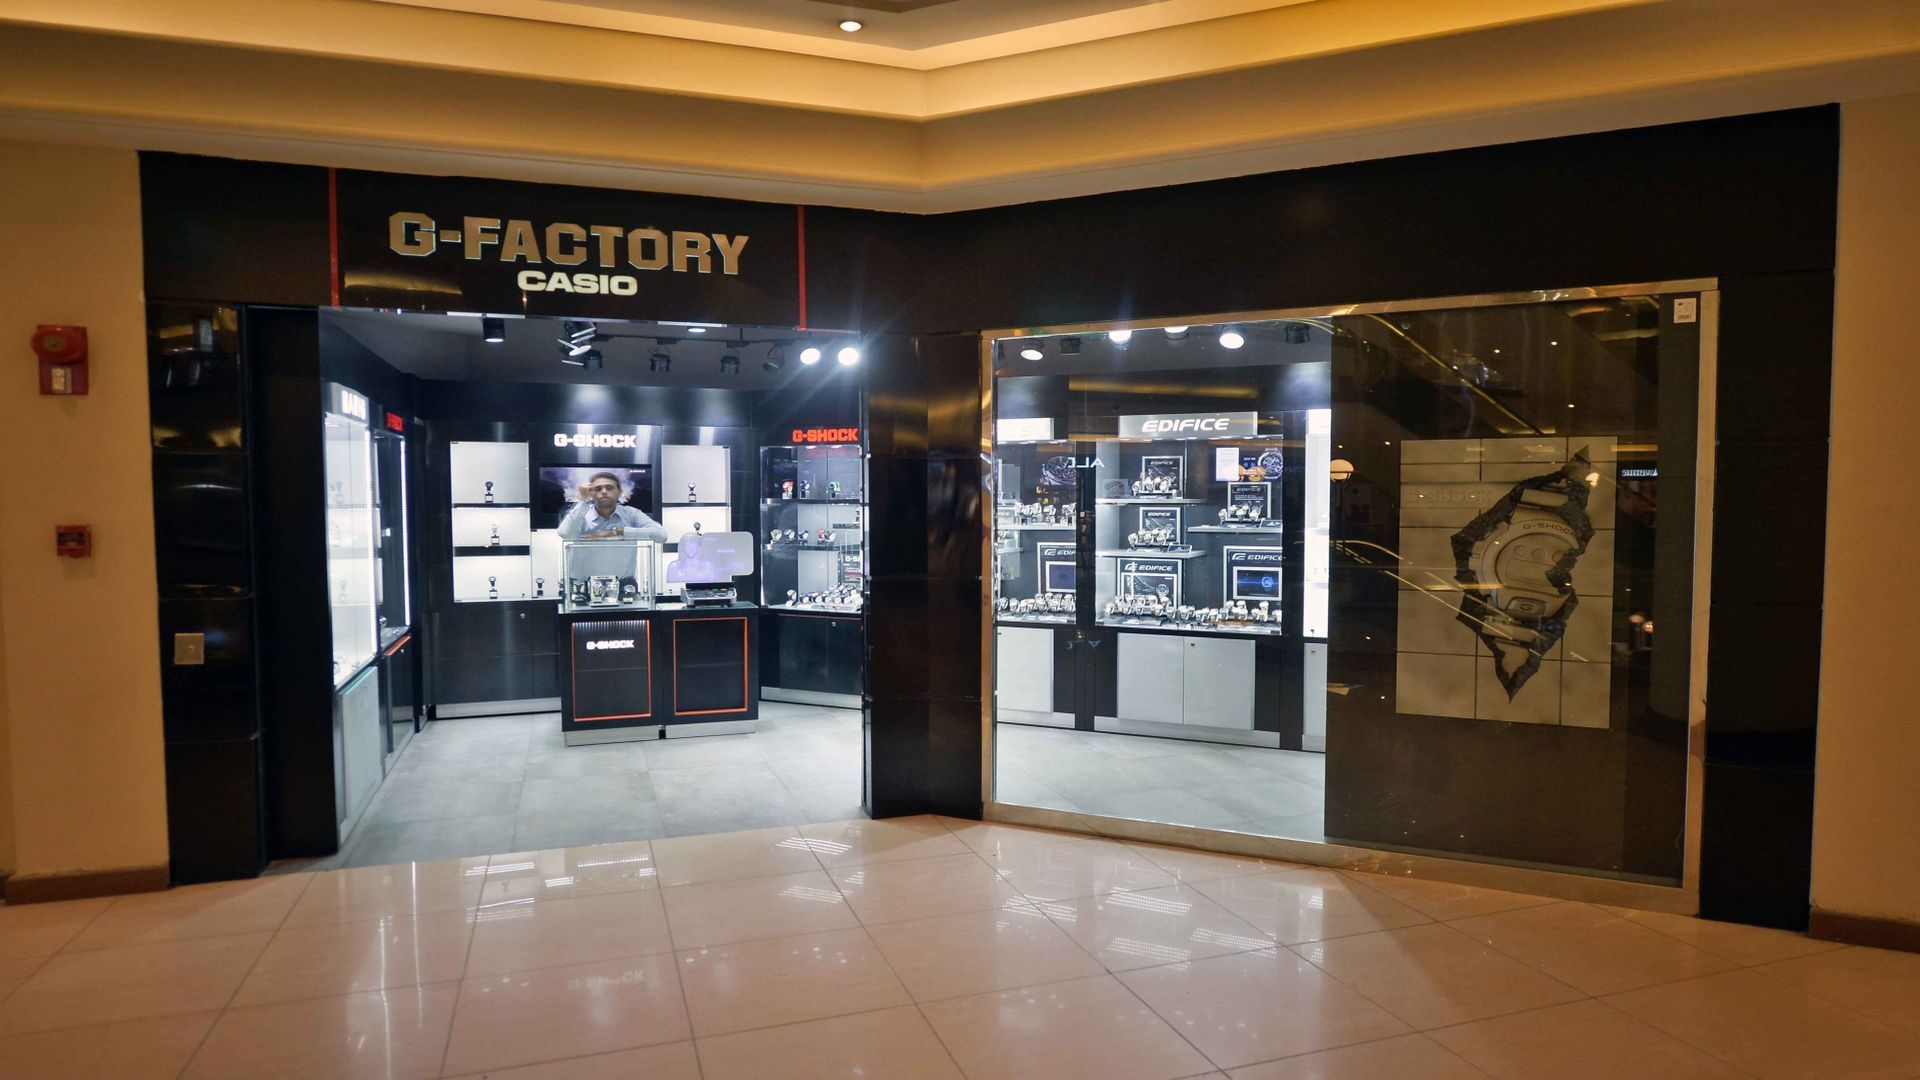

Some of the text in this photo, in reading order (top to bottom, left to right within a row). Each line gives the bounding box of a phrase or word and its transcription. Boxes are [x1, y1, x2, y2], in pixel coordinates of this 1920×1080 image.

[389, 211, 749, 275] G-FACTORY
[517, 270, 638, 296] CASIO
[1141, 418, 1230, 433] EDIFICE
[553, 433, 637, 448] G-SHOCK
[792, 428, 859, 443] G-SHOCK
[1139, 564, 1173, 572] EDIFICE
